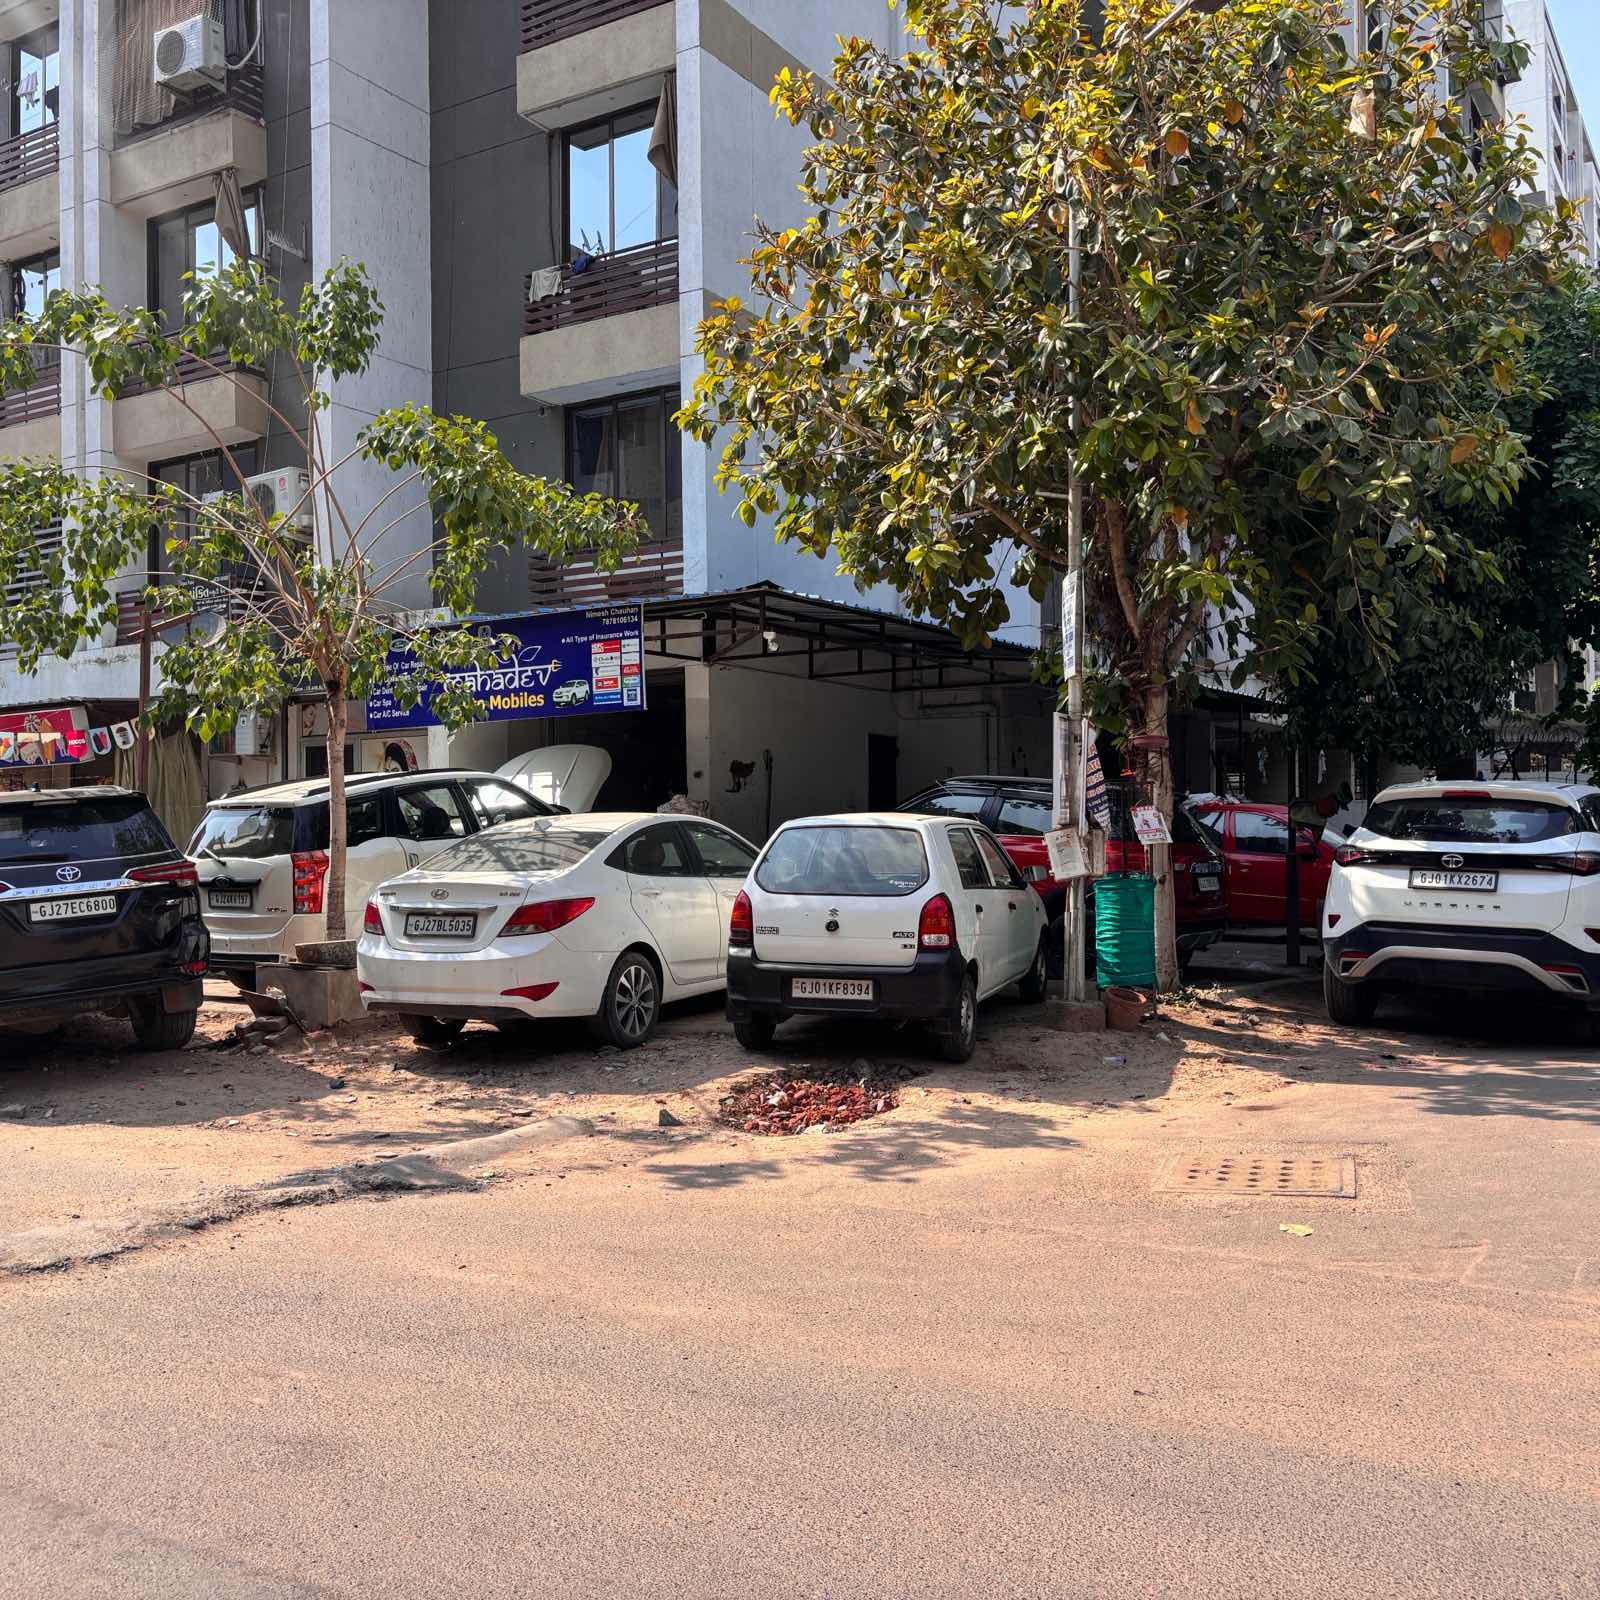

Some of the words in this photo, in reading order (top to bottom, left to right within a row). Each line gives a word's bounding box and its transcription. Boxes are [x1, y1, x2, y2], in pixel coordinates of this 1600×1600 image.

[575, 636, 588, 644] Type
[596, 632, 623, 640] Insurance
[373, 688, 381, 696] Car
[382, 699, 392, 708] Spa
[489, 692, 545, 710] Mobiles
[1420, 872, 1493, 887] GJ01KX2674
[39, 898, 115, 917] GJ27EC6800
[414, 919, 472, 932] GJ27BL5035
[800, 981, 870, 997] GJ01KF8394
